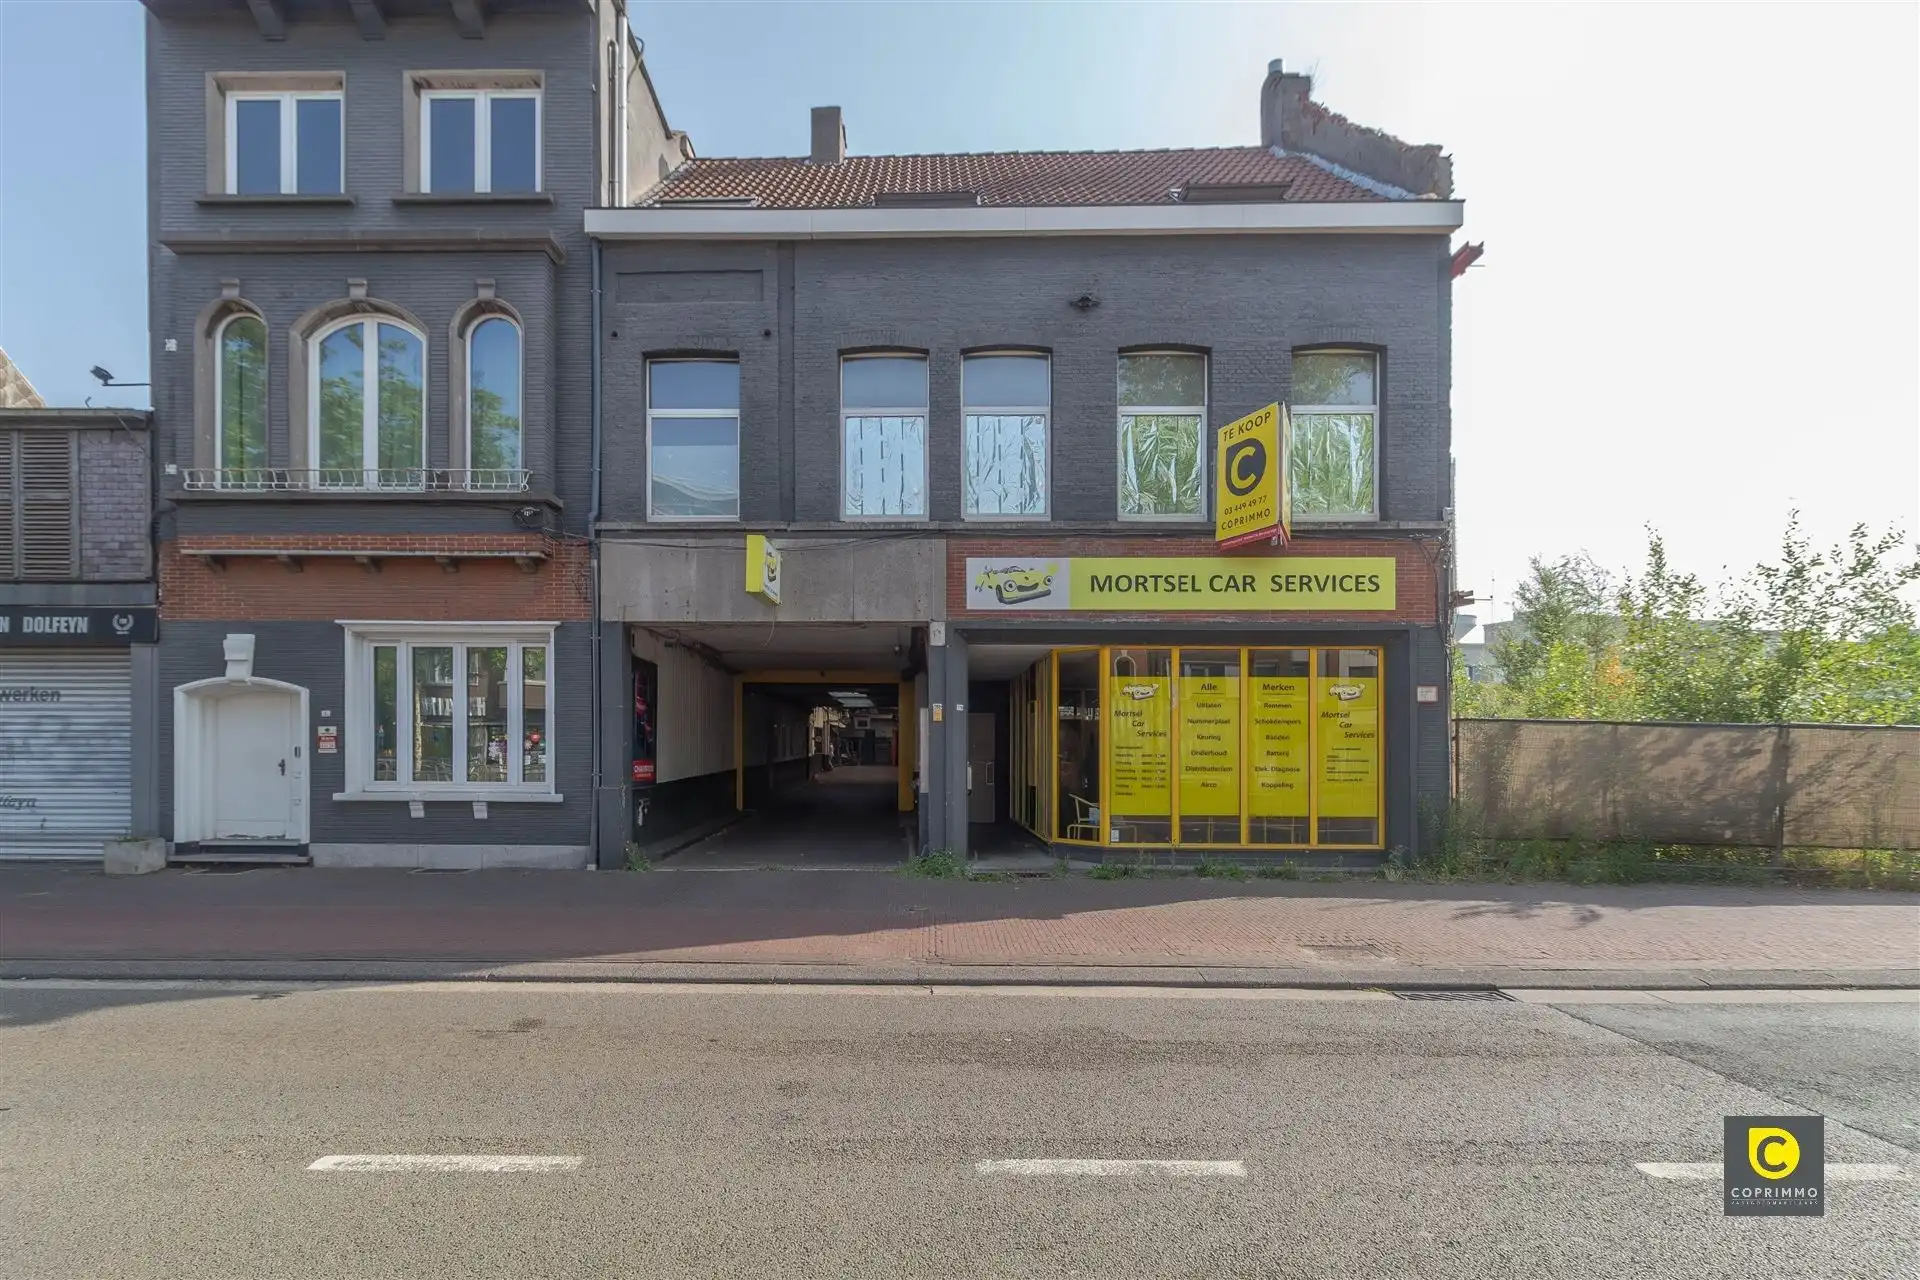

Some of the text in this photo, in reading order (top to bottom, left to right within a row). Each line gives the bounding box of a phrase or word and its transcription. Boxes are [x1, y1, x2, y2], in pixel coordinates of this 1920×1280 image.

[1223, 411, 1271, 442] TE KOOP
[1224, 506, 1232, 515] 03
[1234, 502, 1246, 512] 449
[1248, 498, 1257, 507] 49
[1221, 508, 1270, 530] COPRIMMO
[1090, 574, 1380, 593] MORTSEL CAR SERVICES
[22, 616, 89, 633] DOLFEYN
[1200, 683, 1218, 691] Alle
[1262, 683, 1295, 691] Merken
[1320, 711, 1350, 719] Mortsel
[1344, 731, 1375, 739] Services
